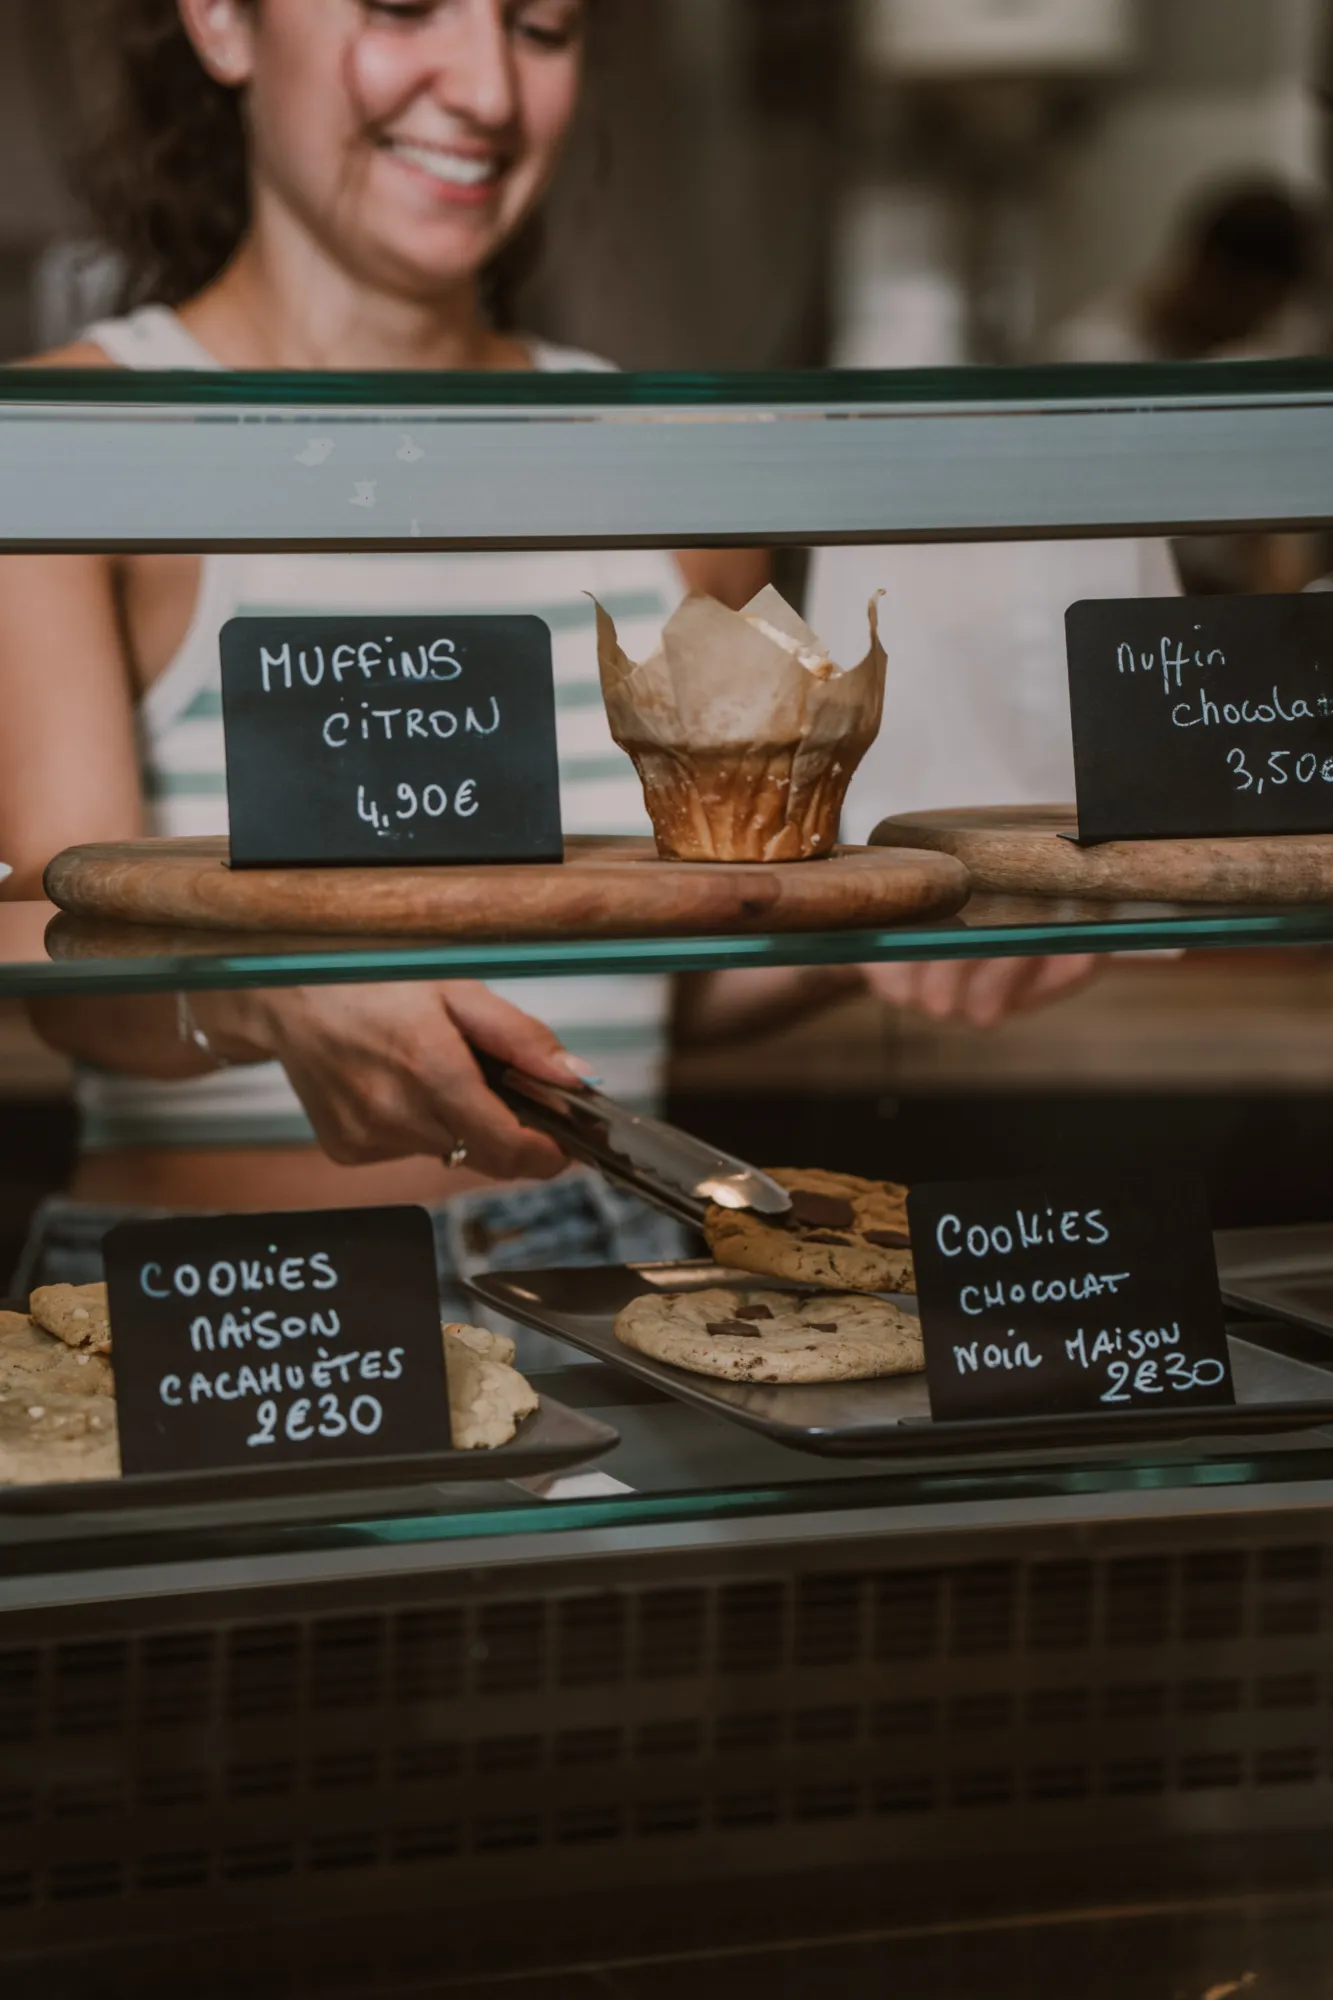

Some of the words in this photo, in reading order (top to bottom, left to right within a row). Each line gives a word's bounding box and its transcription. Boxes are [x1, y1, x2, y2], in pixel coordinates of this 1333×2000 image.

[357, 779, 479, 828] 4,90€
[959, 1272, 1131, 1316] CHOCOLAT
[159, 1346, 405, 1407] CACAHUÈTES
[1099, 1353, 1225, 1402] 2€30
[246, 1393, 383, 1447] 2€30
